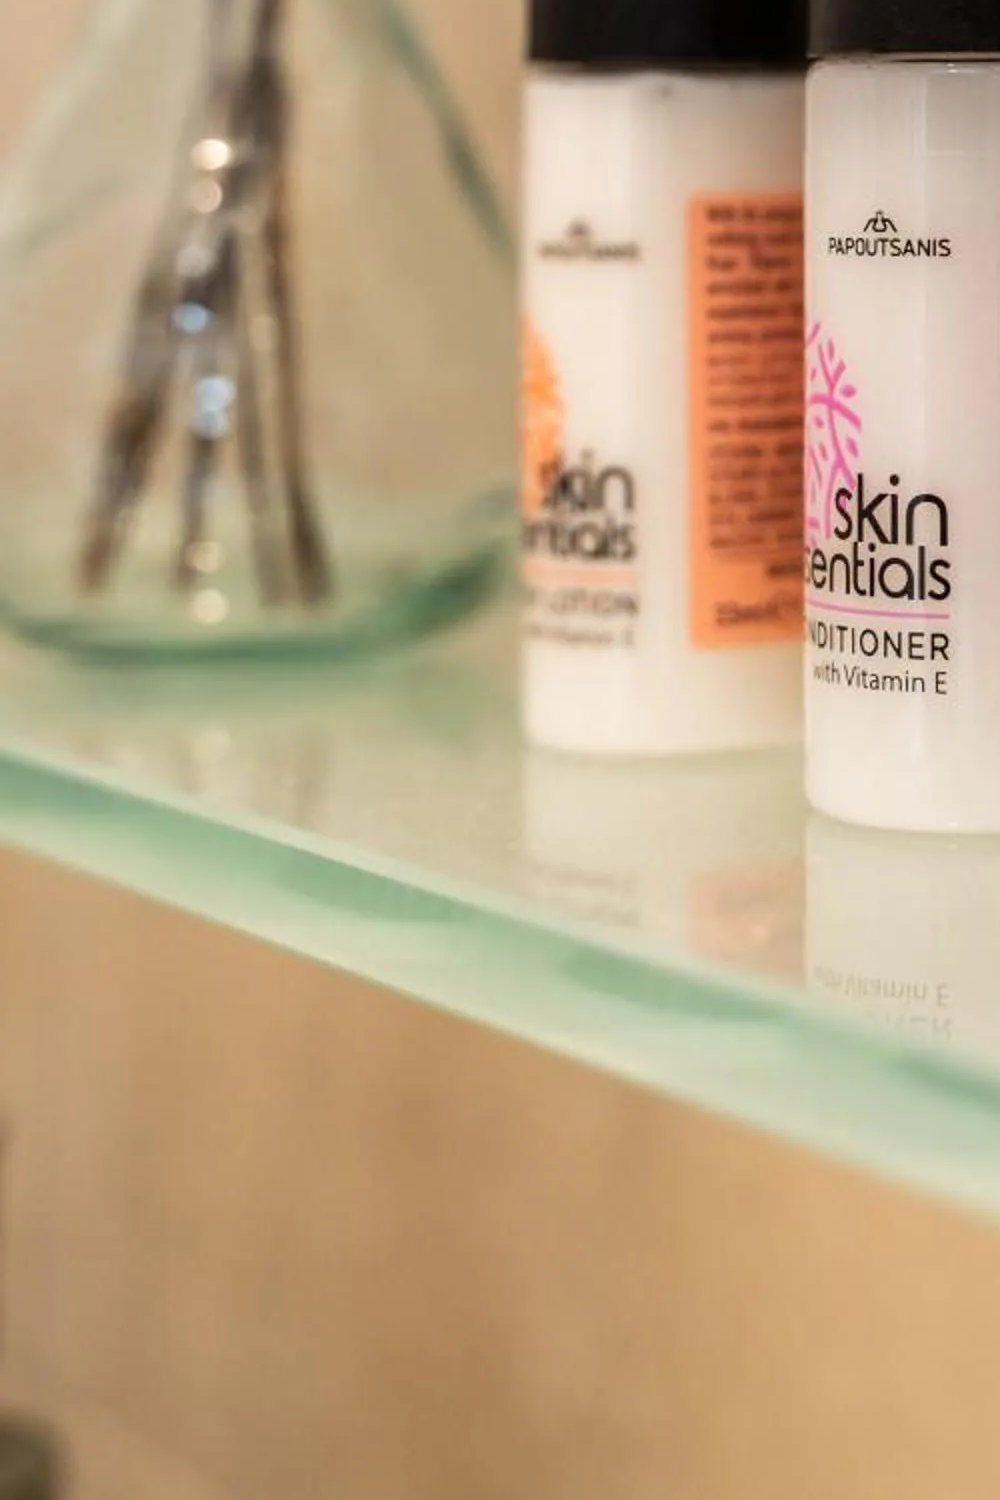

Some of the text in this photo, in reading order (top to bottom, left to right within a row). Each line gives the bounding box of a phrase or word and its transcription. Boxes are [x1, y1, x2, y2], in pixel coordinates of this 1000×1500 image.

[828, 237, 952, 258] PAPOUTSANIS
[834, 473, 949, 547] skin
[806, 542, 951, 600] entials
[843, 664, 926, 693] Vitamin
[935, 672, 948, 695] E
